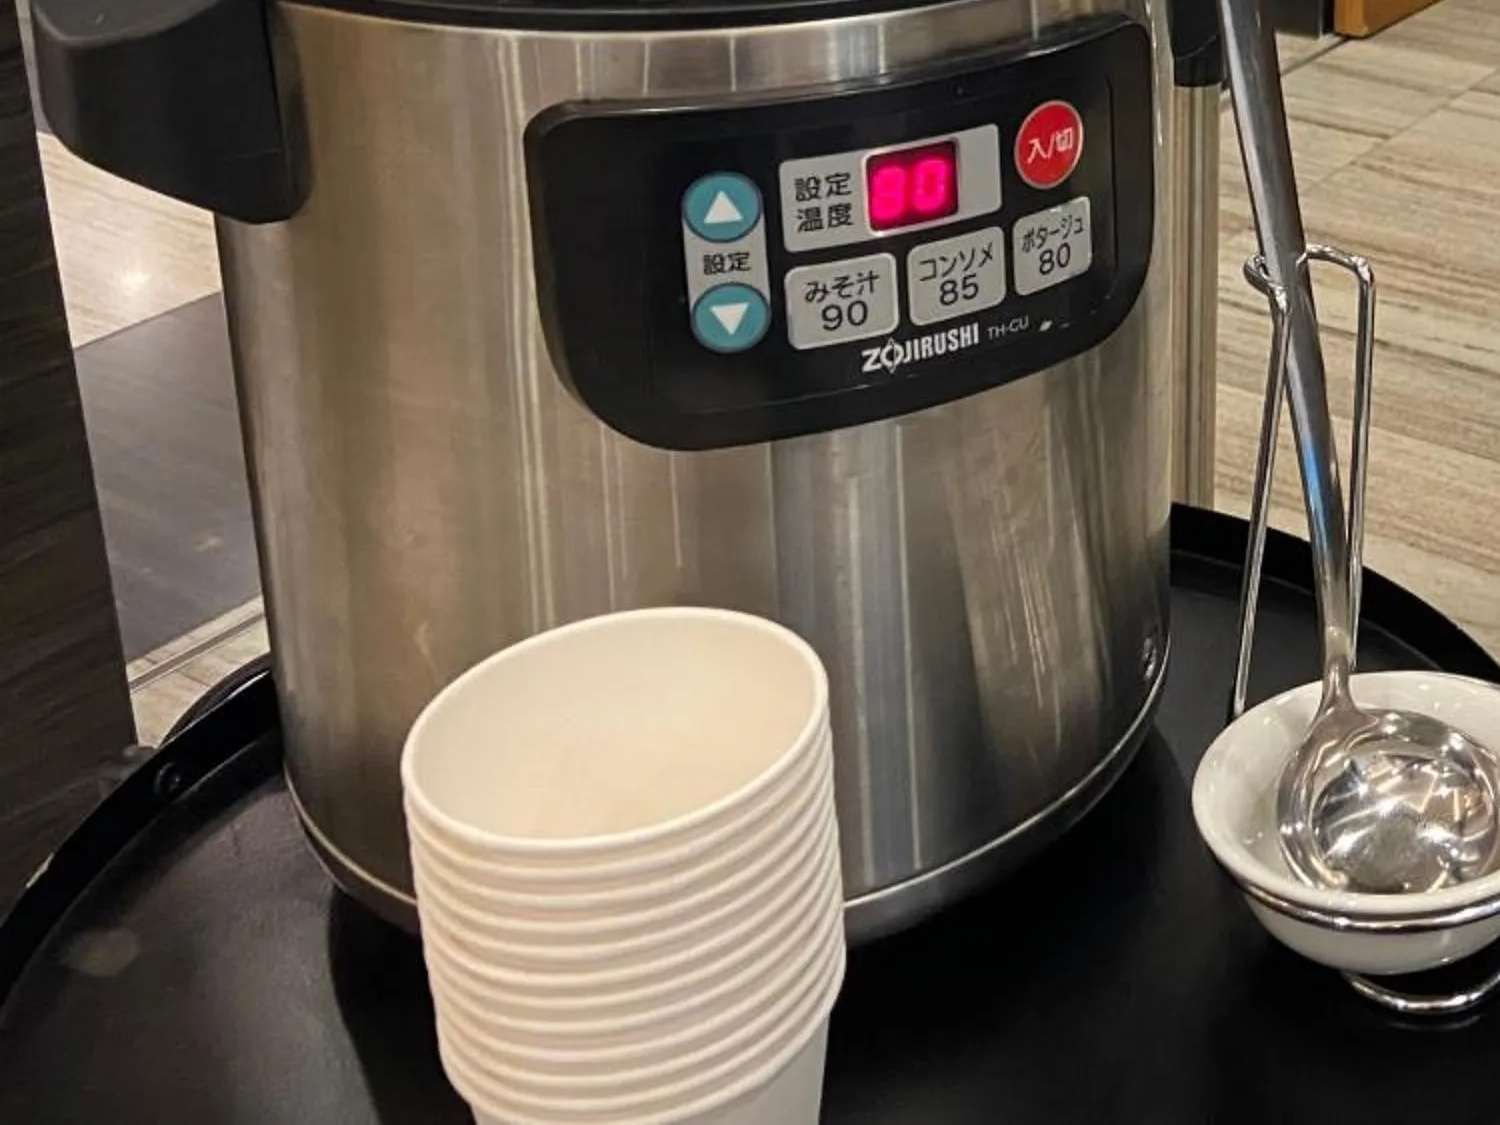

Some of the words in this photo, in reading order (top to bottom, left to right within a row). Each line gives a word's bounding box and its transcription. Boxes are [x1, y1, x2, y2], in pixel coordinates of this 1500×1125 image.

[1027, 131, 1074, 164] 入/切
[794, 172, 852, 200] 設定
[797, 204, 854, 232] 温度
[1021, 213, 1085, 253] ポタージュ
[703, 251, 751, 276] 設定
[919, 243, 994, 281] コンソメ
[1038, 244, 1071, 275] 80
[804, 271, 880, 303] みそ汁
[939, 276, 980, 306] 85
[821, 300, 869, 331] 90
[861, 322, 980, 373] ZOJIRUSHI
